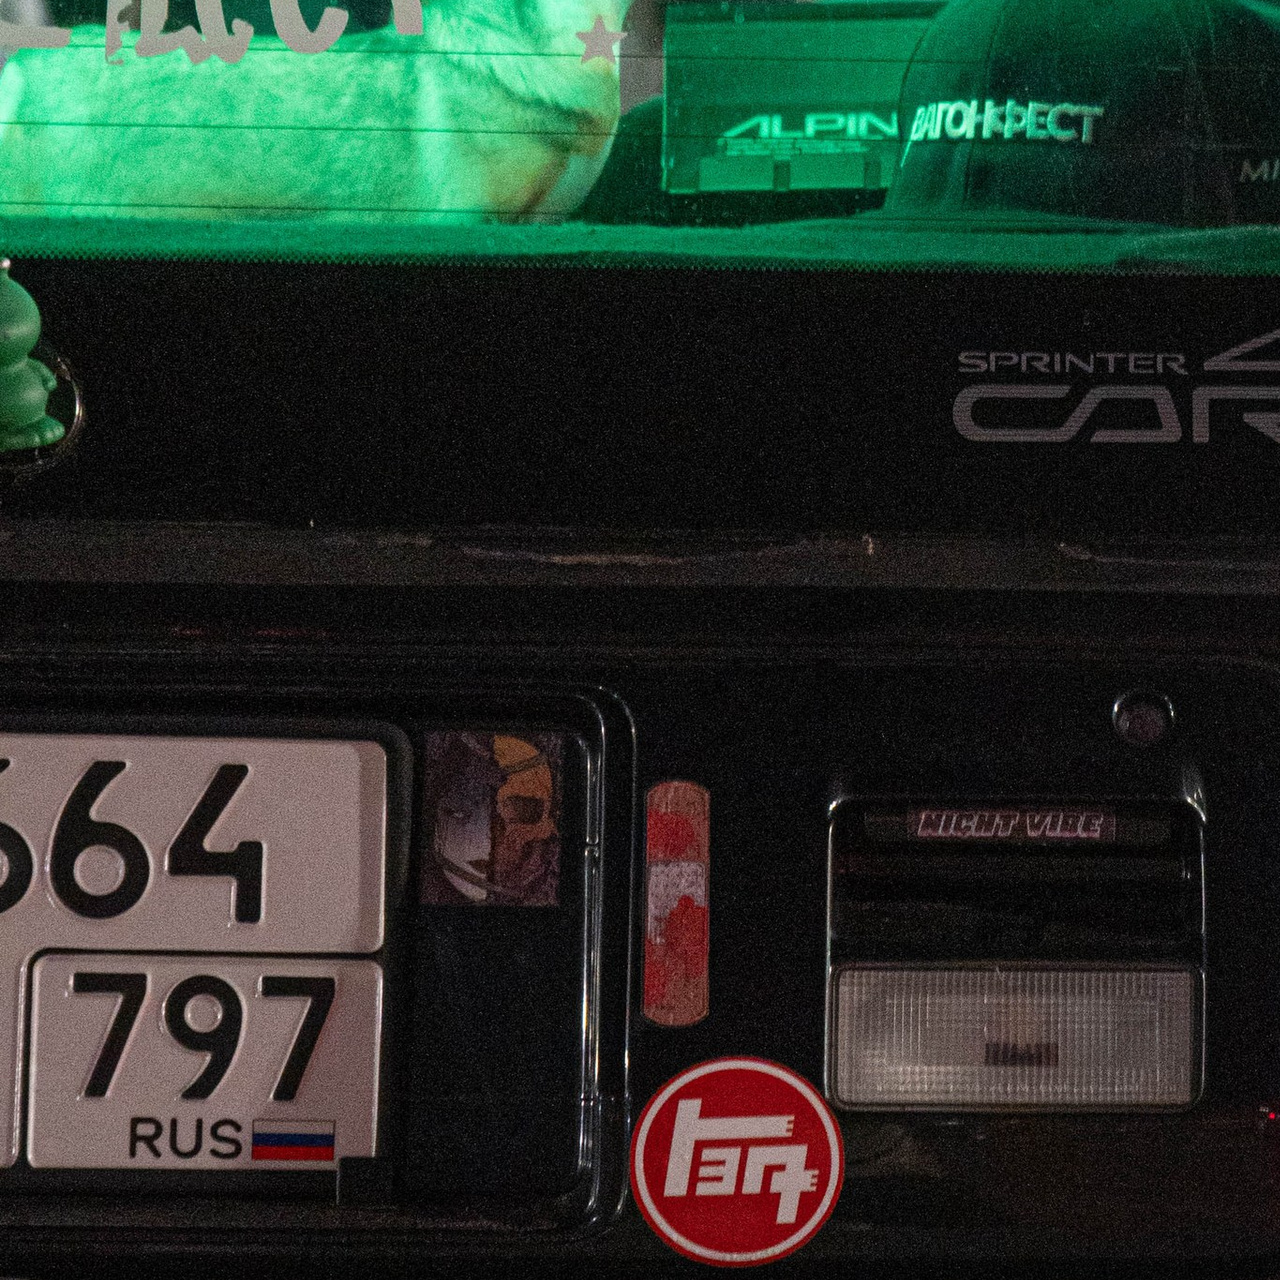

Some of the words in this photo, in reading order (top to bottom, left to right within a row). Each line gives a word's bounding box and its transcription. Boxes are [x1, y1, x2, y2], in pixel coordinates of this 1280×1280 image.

[723, 111, 899, 139] ALPIN
[957, 351, 1190, 376] SPRINTER
[72, 972, 336, 1102] 797
[129, 1117, 243, 1160] RUS
